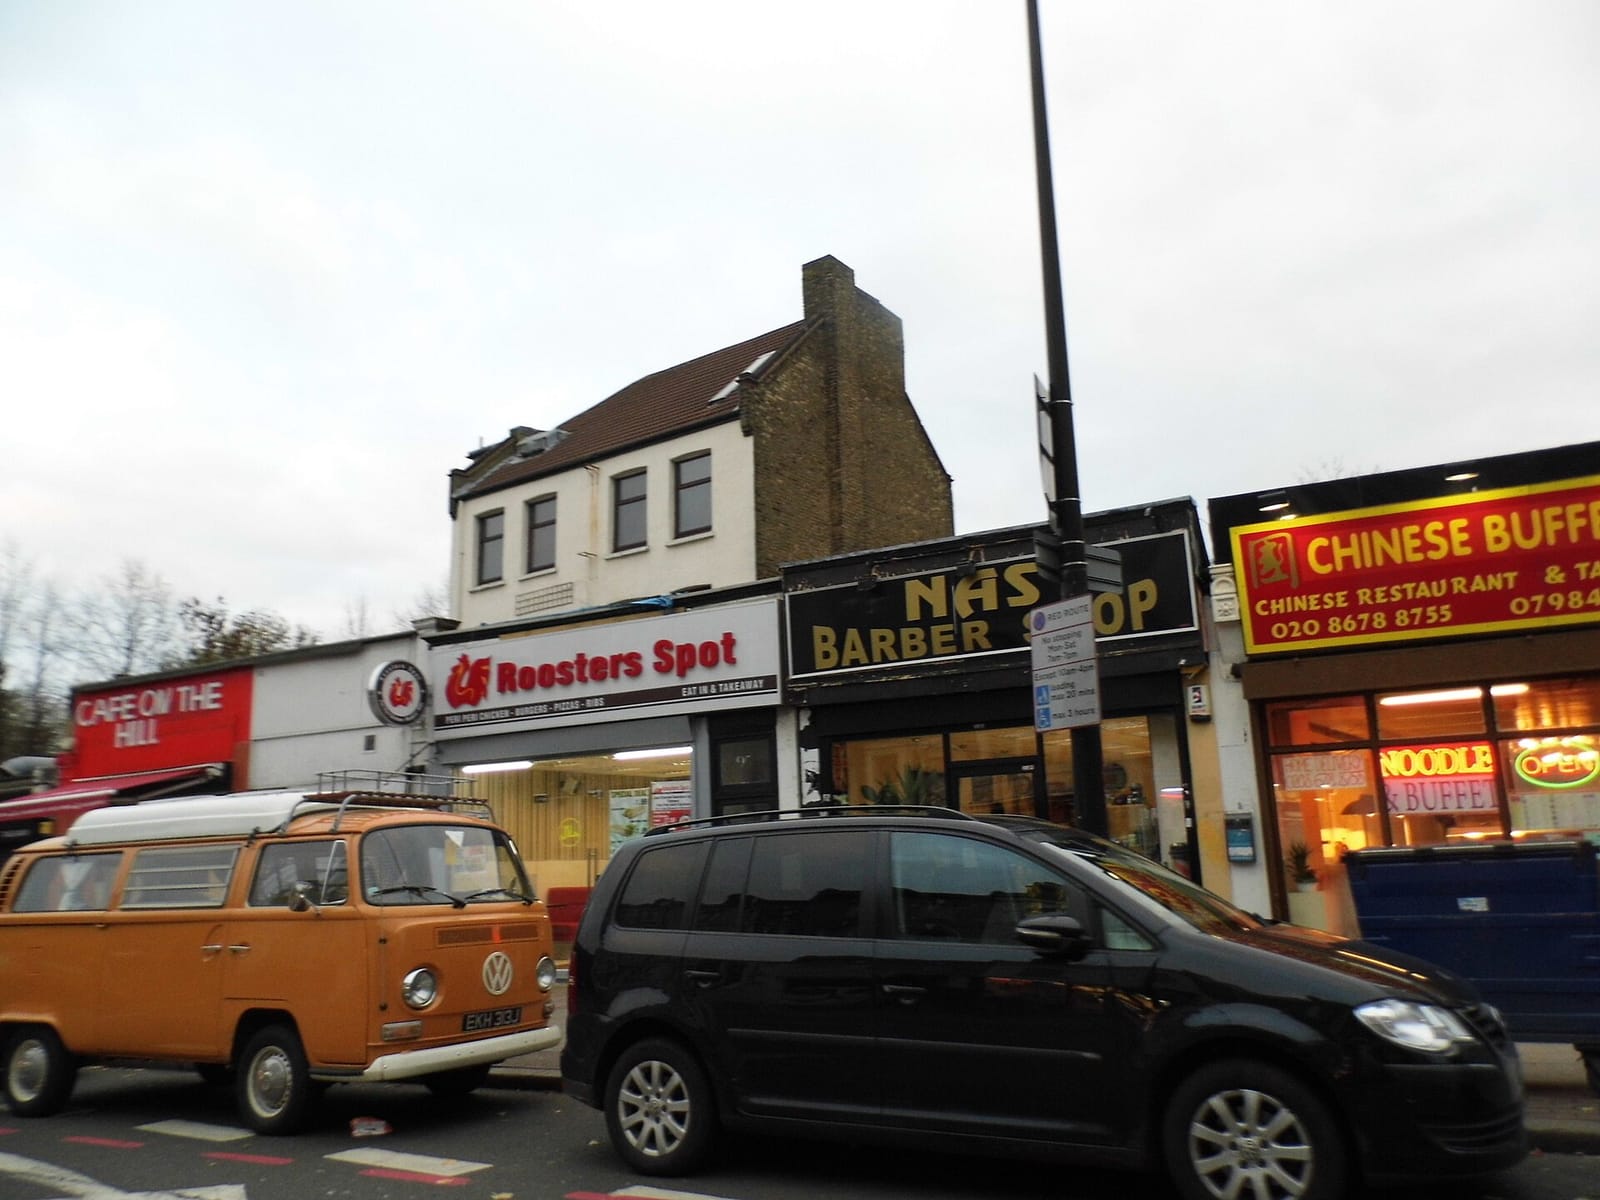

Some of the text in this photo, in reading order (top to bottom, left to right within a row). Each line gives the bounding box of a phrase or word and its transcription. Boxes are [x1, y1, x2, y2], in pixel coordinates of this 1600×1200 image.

[1307, 518, 1471, 574] CHINESE
[1255, 591, 1349, 616] CHINESE
[1357, 571, 1518, 605] RESTAURANT
[1544, 564, 1566, 584] &
[812, 578, 1158, 670] BARBER OP
[1047, 603, 1089, 621] RED ROUTE
[1271, 588, 1600, 639] 020 8678 8755 07984
[496, 631, 737, 694] Roosters Spot
[75, 681, 223, 727] CAFE ON THE
[682, 679, 765, 697] EAT IN & TAKEAWAY
[479, 709, 510, 721] CHICKEN
[515, 704, 548, 716] BURGERS
[554, 700, 580, 712] PIZZAS
[586, 697, 605, 708] RIBS
[113, 718, 160, 748] HILL
[1379, 745, 1495, 778] NOODLE
[1403, 779, 1499, 811] BUFFET
[465, 1011, 493, 1030] EKH
